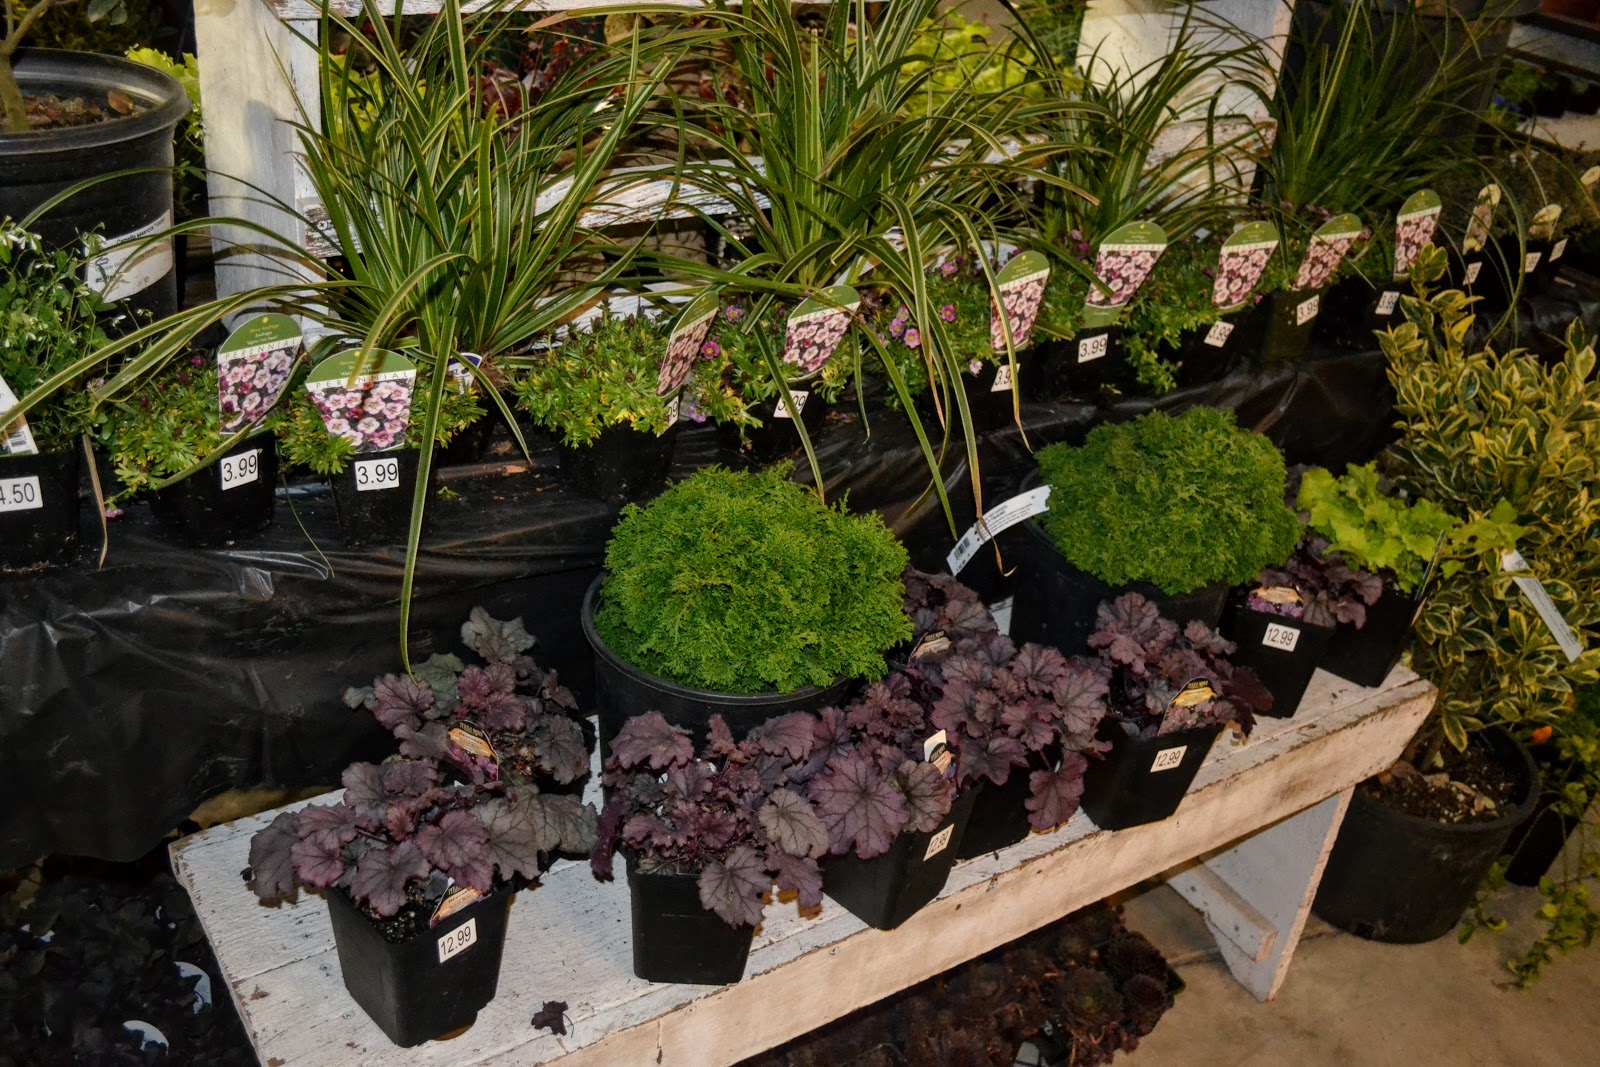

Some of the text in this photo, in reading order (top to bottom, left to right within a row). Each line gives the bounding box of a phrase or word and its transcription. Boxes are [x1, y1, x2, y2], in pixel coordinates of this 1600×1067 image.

[1080, 338, 1107, 357] 3.99
[316, 371, 408, 388] PERNNIAL
[223, 454, 257, 482] 3.99
[357, 463, 398, 484] 3.99
[1267, 627, 1294, 646] 12.99
[1155, 750, 1181, 767] 12.99
[441, 926, 471, 955] 12.99
